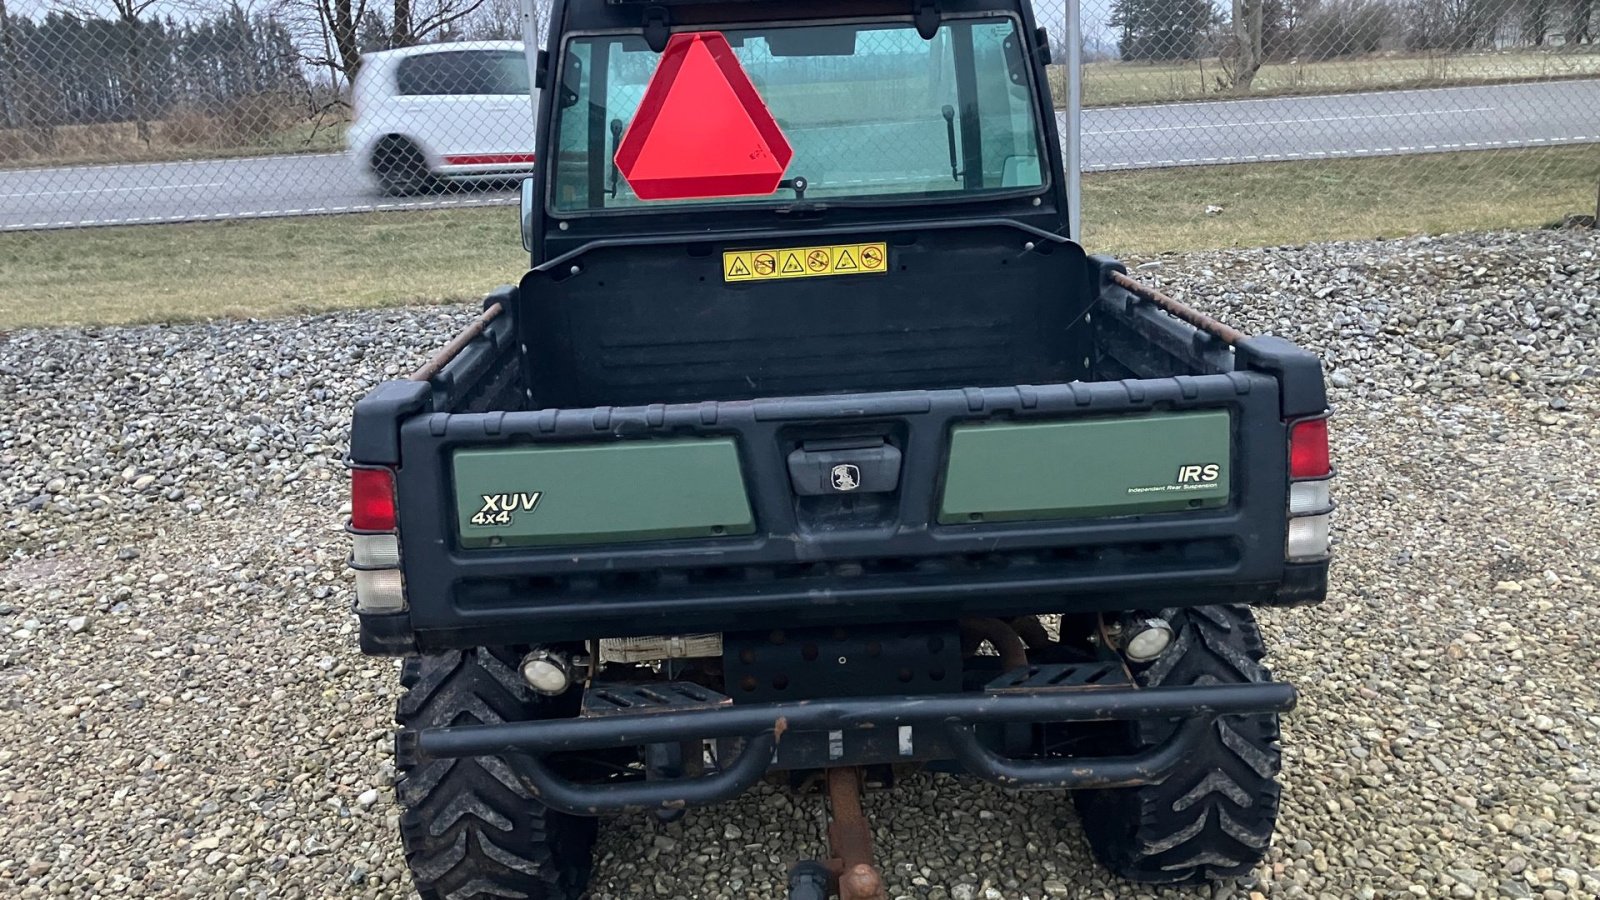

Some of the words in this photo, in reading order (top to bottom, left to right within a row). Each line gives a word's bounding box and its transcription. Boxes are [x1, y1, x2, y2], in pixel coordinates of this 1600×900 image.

[1178, 464, 1220, 483] IRS
[481, 492, 540, 511] XUV
[471, 511, 510, 525] 4x4
